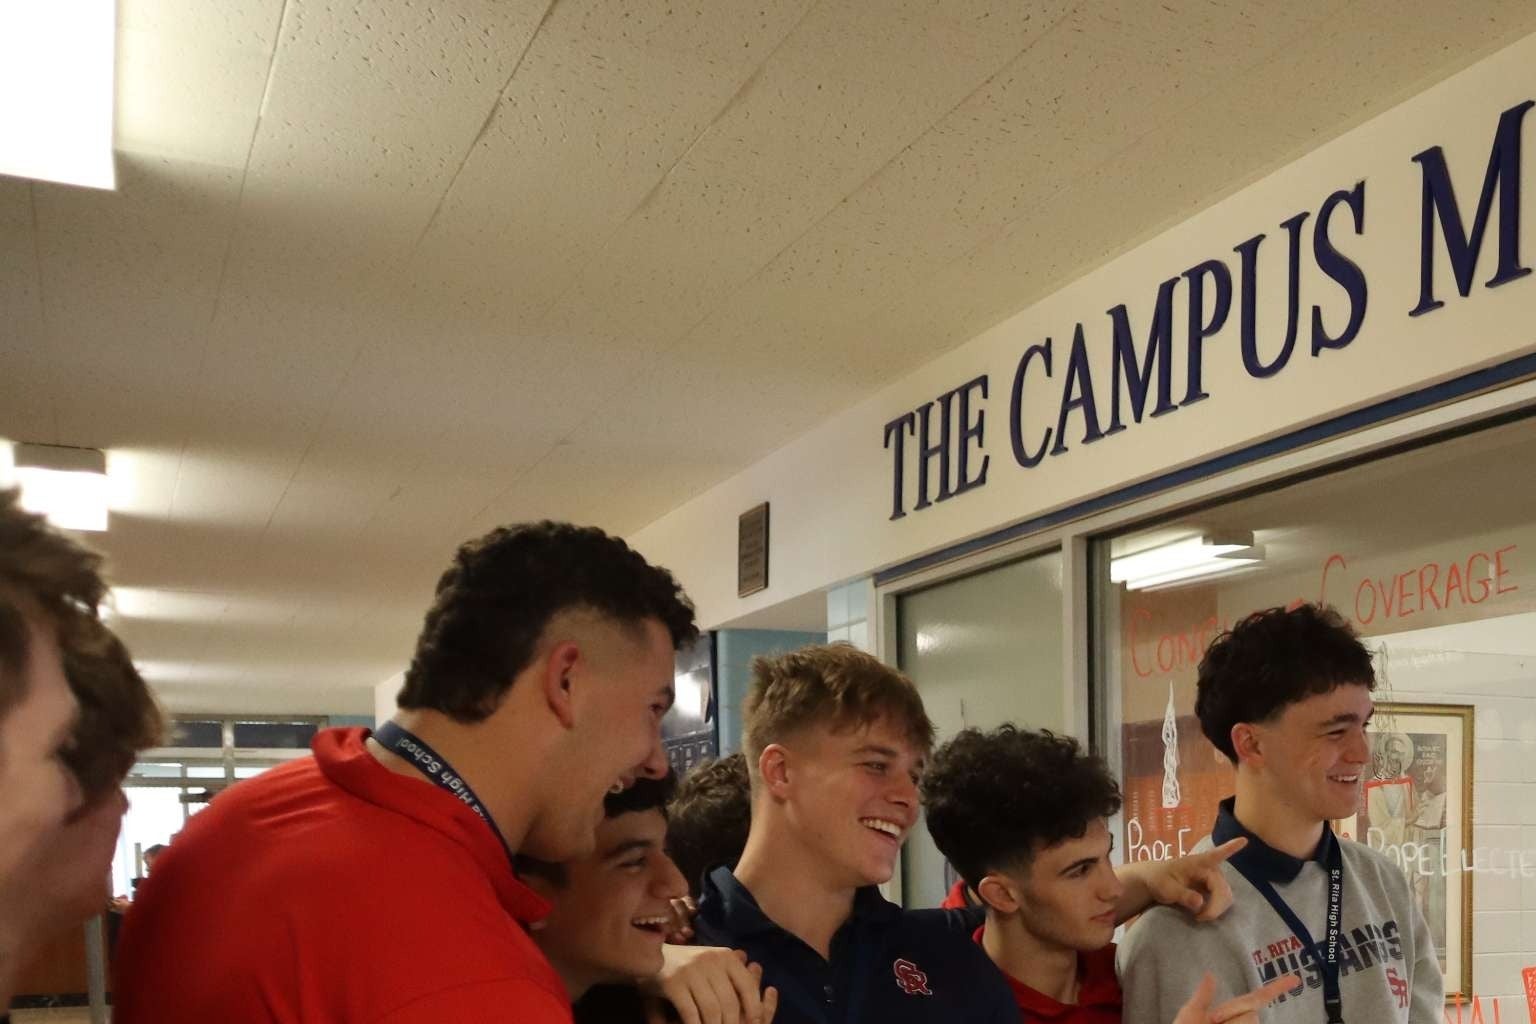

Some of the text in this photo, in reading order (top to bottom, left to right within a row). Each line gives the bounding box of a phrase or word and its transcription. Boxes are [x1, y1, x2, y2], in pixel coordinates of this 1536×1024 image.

[883, 375, 989, 521] THE
[1009, 179, 1369, 470] CAMPUS
[1266, 935, 1303, 959] RITA
[1327, 869, 1340, 963] St. Rita High School
